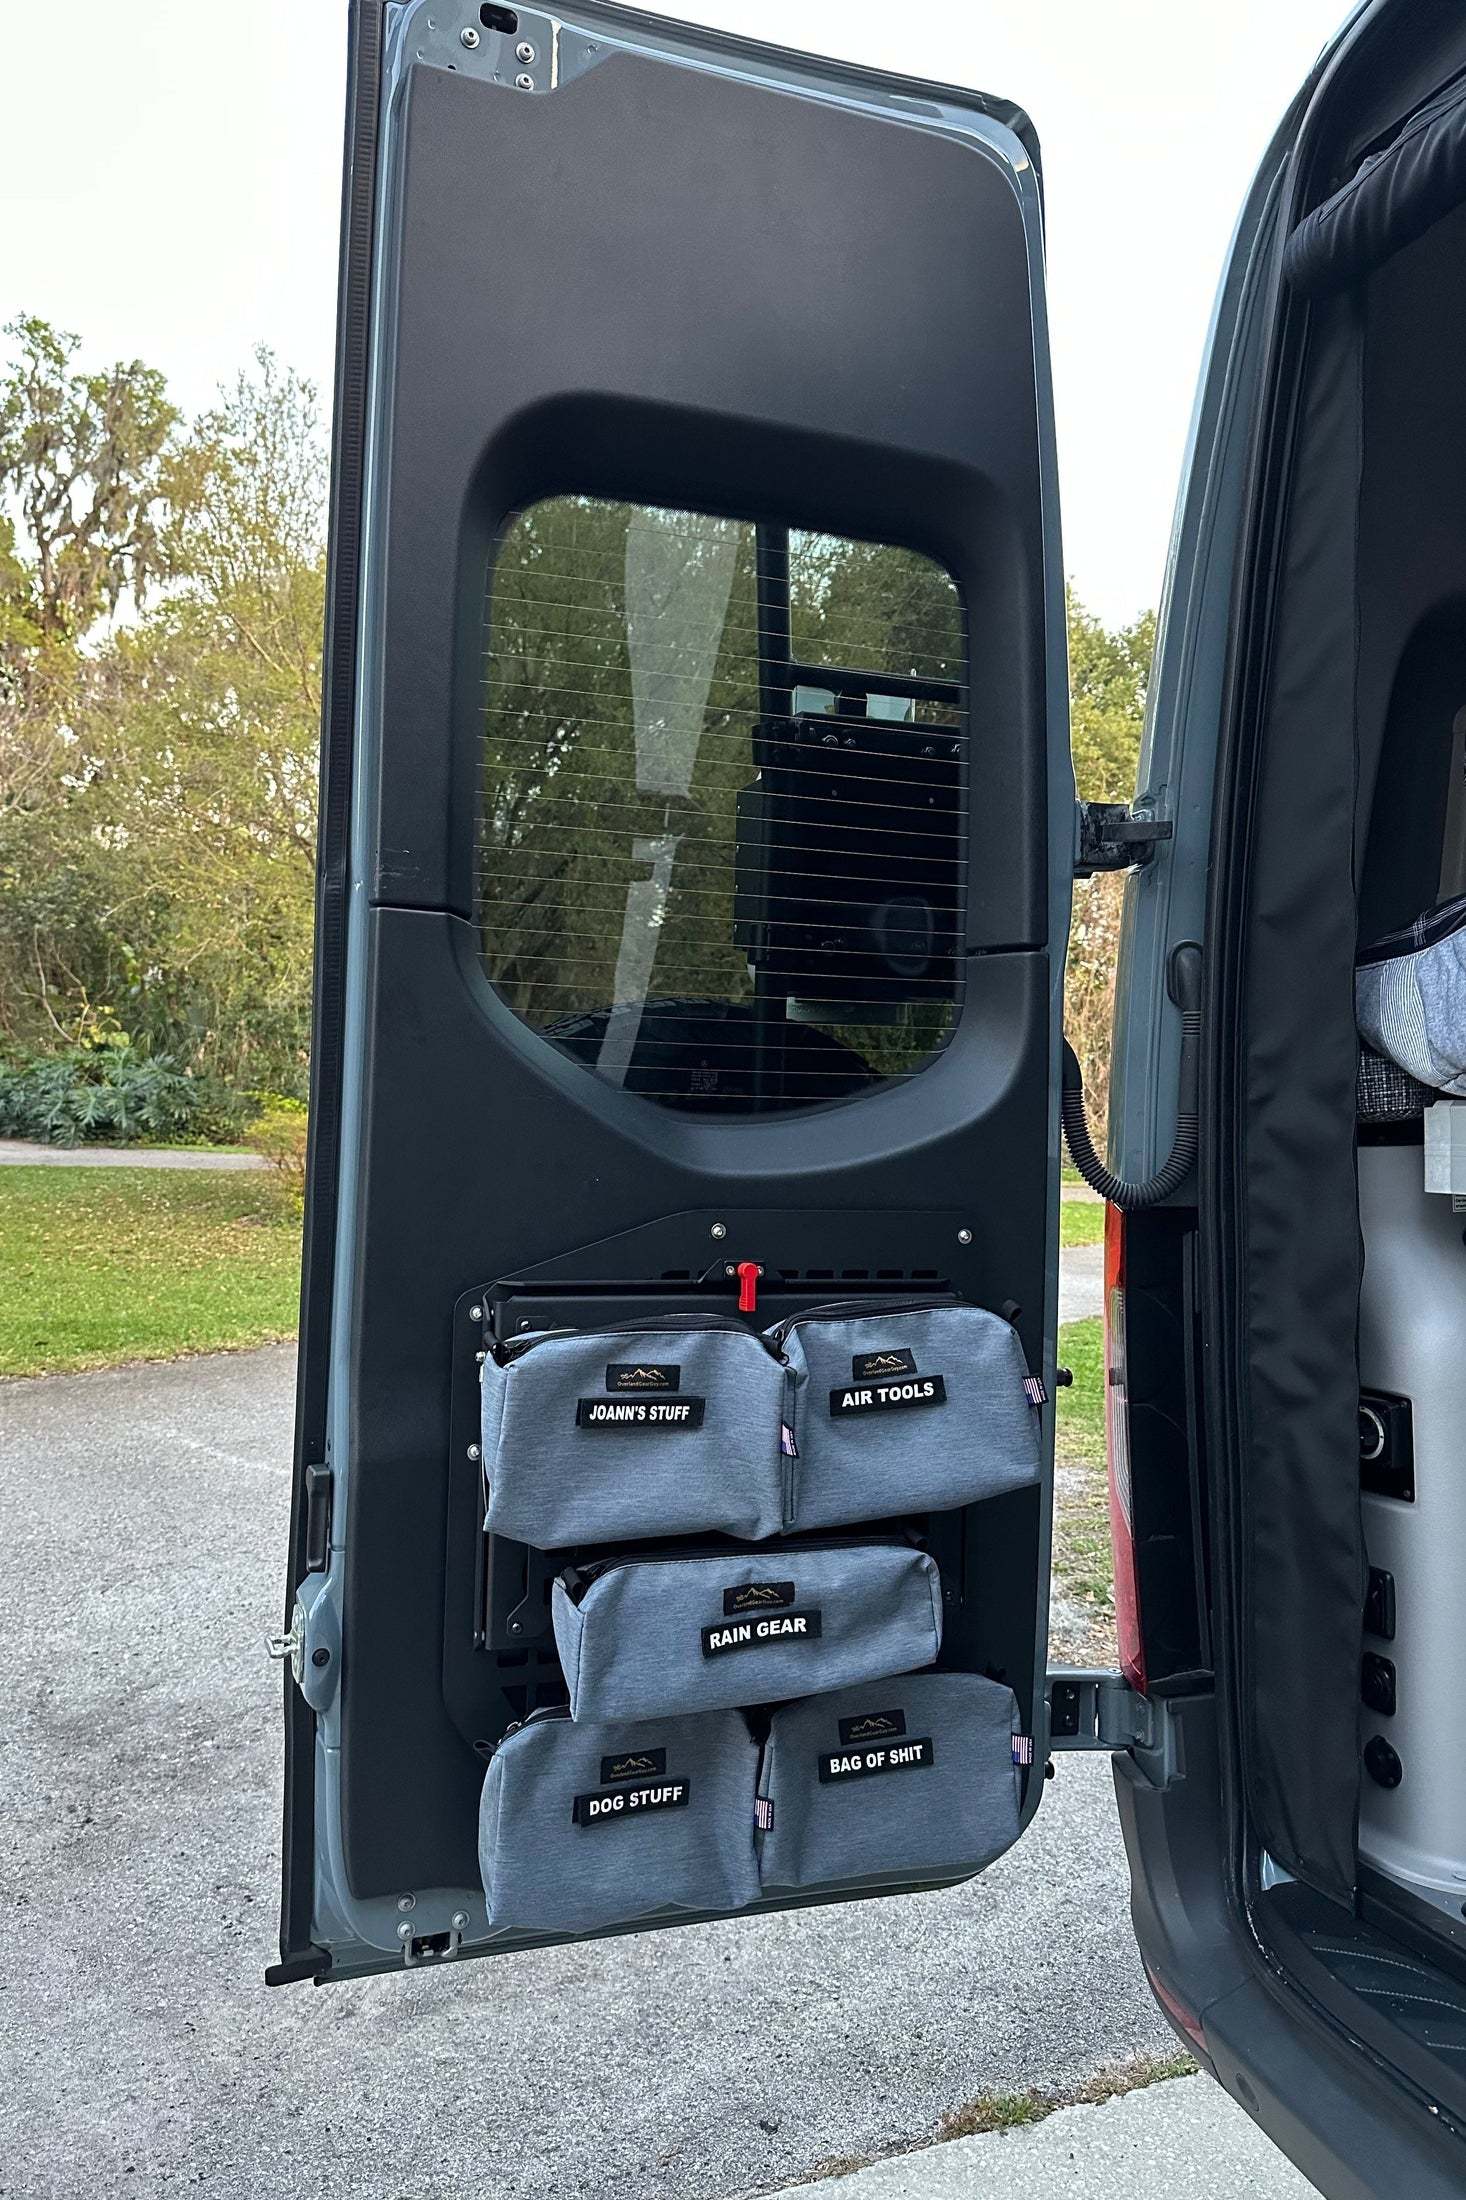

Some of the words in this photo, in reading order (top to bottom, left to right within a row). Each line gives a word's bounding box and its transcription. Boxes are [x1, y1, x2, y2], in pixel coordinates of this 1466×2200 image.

[841, 1390, 873, 1408] AIR
[877, 1382, 935, 1403] TOOLS
[589, 1404, 646, 1421] JOANN'S
[649, 1405, 690, 1421] STUFF
[709, 1624, 751, 1650] RAIN
[756, 1617, 807, 1638] GEAR
[830, 1755, 861, 1774] BAG
[866, 1751, 885, 1768] OF
[889, 1745, 923, 1765] SHIT
[589, 1795, 624, 1816] DOG
[629, 1786, 683, 1808] STUFF
